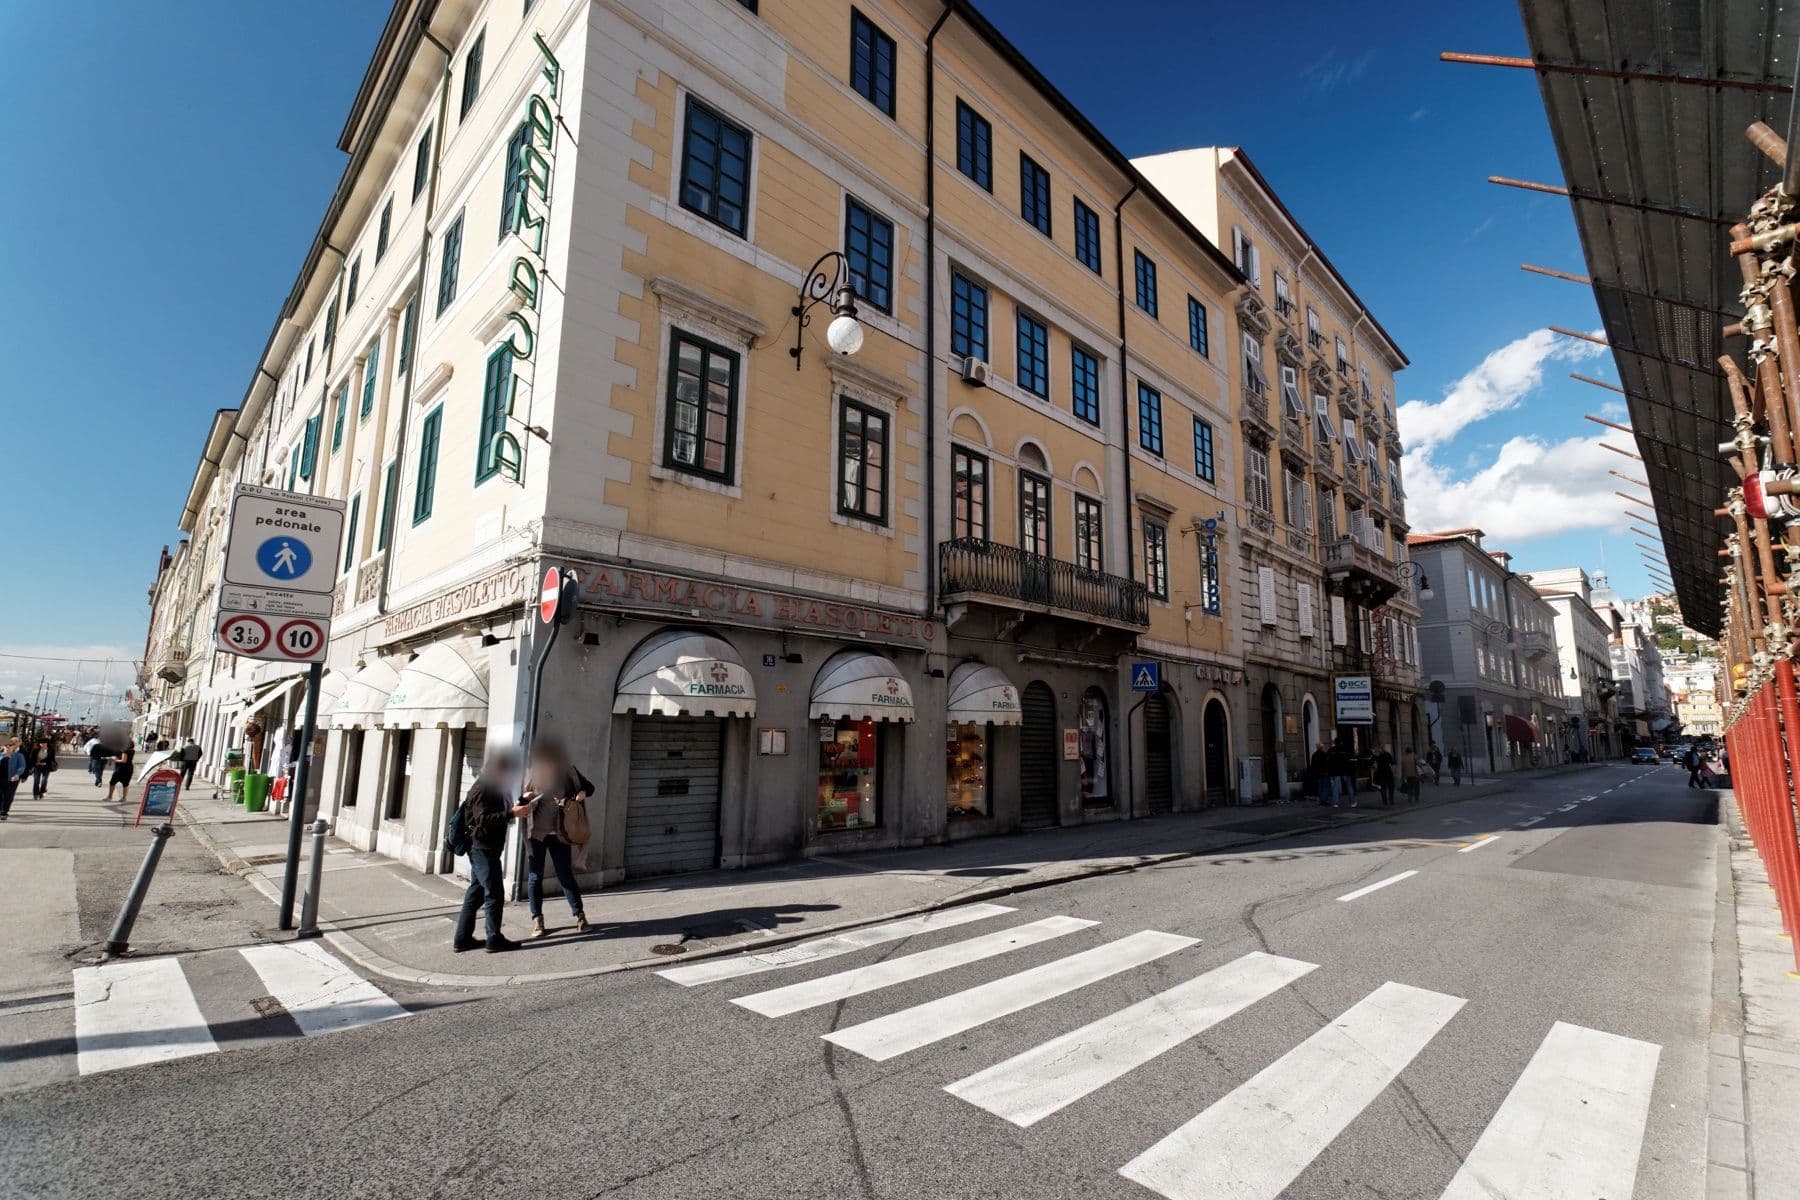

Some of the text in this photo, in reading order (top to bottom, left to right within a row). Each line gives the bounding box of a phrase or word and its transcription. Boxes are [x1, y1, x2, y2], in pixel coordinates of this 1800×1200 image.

[275, 507, 306, 519] area
[256, 516, 322, 533] pedonale
[384, 567, 520, 637] FARMACIA BIASOLETTO
[289, 630, 313, 649] 10
[689, 683, 746, 695] FARMACIA
